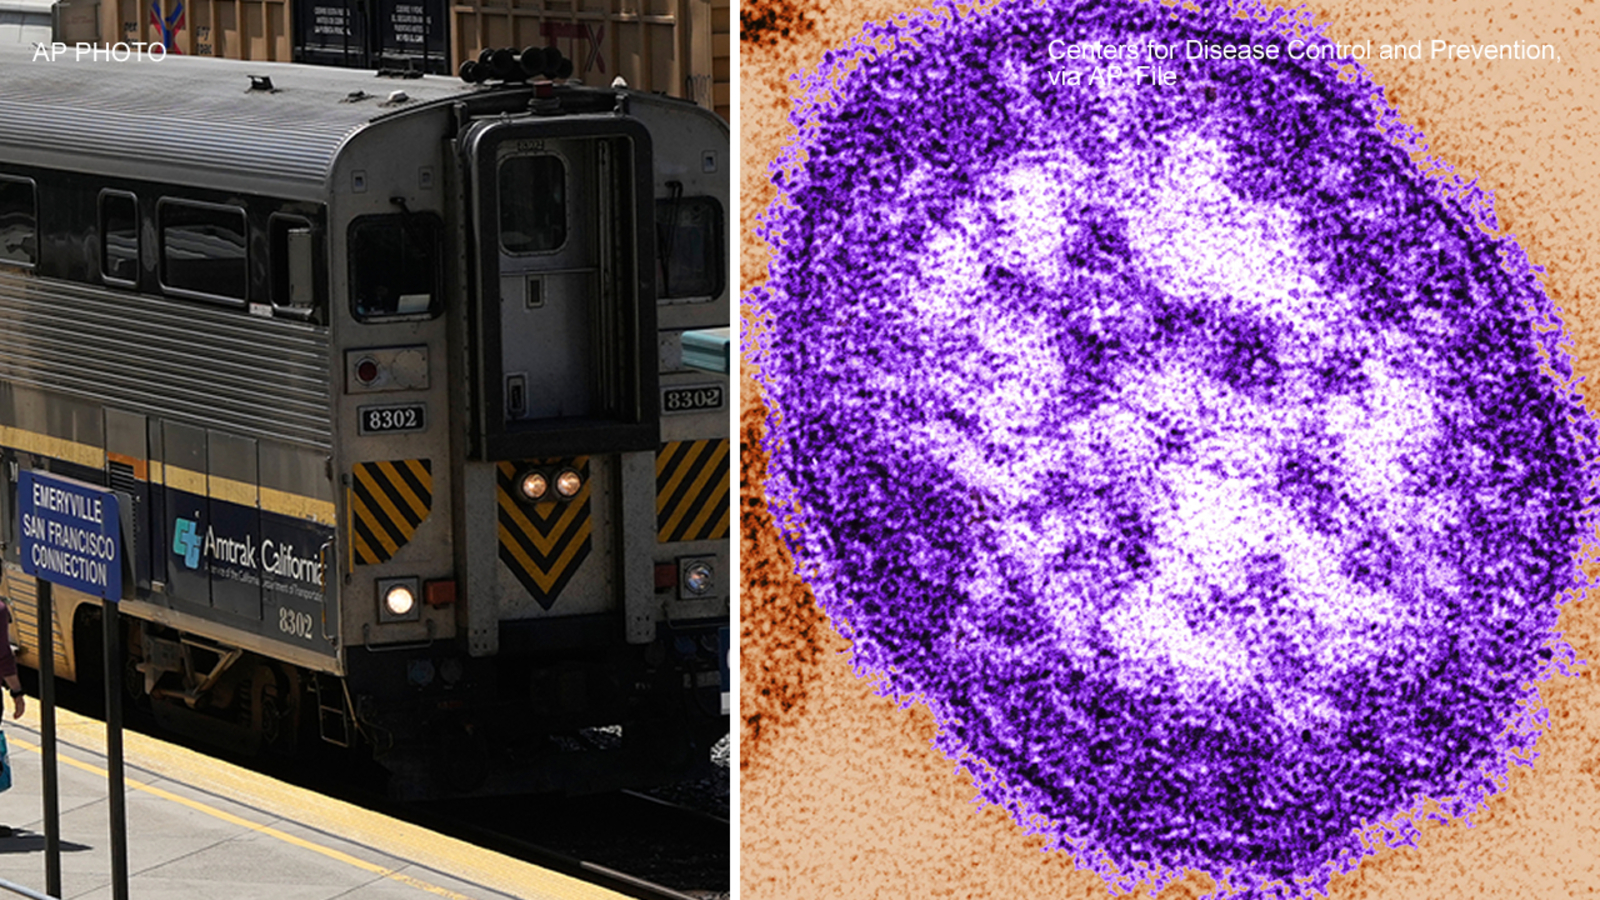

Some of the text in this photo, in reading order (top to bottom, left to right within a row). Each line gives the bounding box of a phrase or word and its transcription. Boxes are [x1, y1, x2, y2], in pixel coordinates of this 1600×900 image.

[369, 409, 417, 429] 8302
[668, 389, 720, 410] 8302
[33, 483, 102, 524] EMERYVILLE
[23, 513, 115, 561] SAN FRANCISCO
[204, 525, 257, 569] Amtrak
[261, 539, 327, 586] California
[32, 543, 107, 587] CONNECTION
[279, 606, 313, 639] 8302
